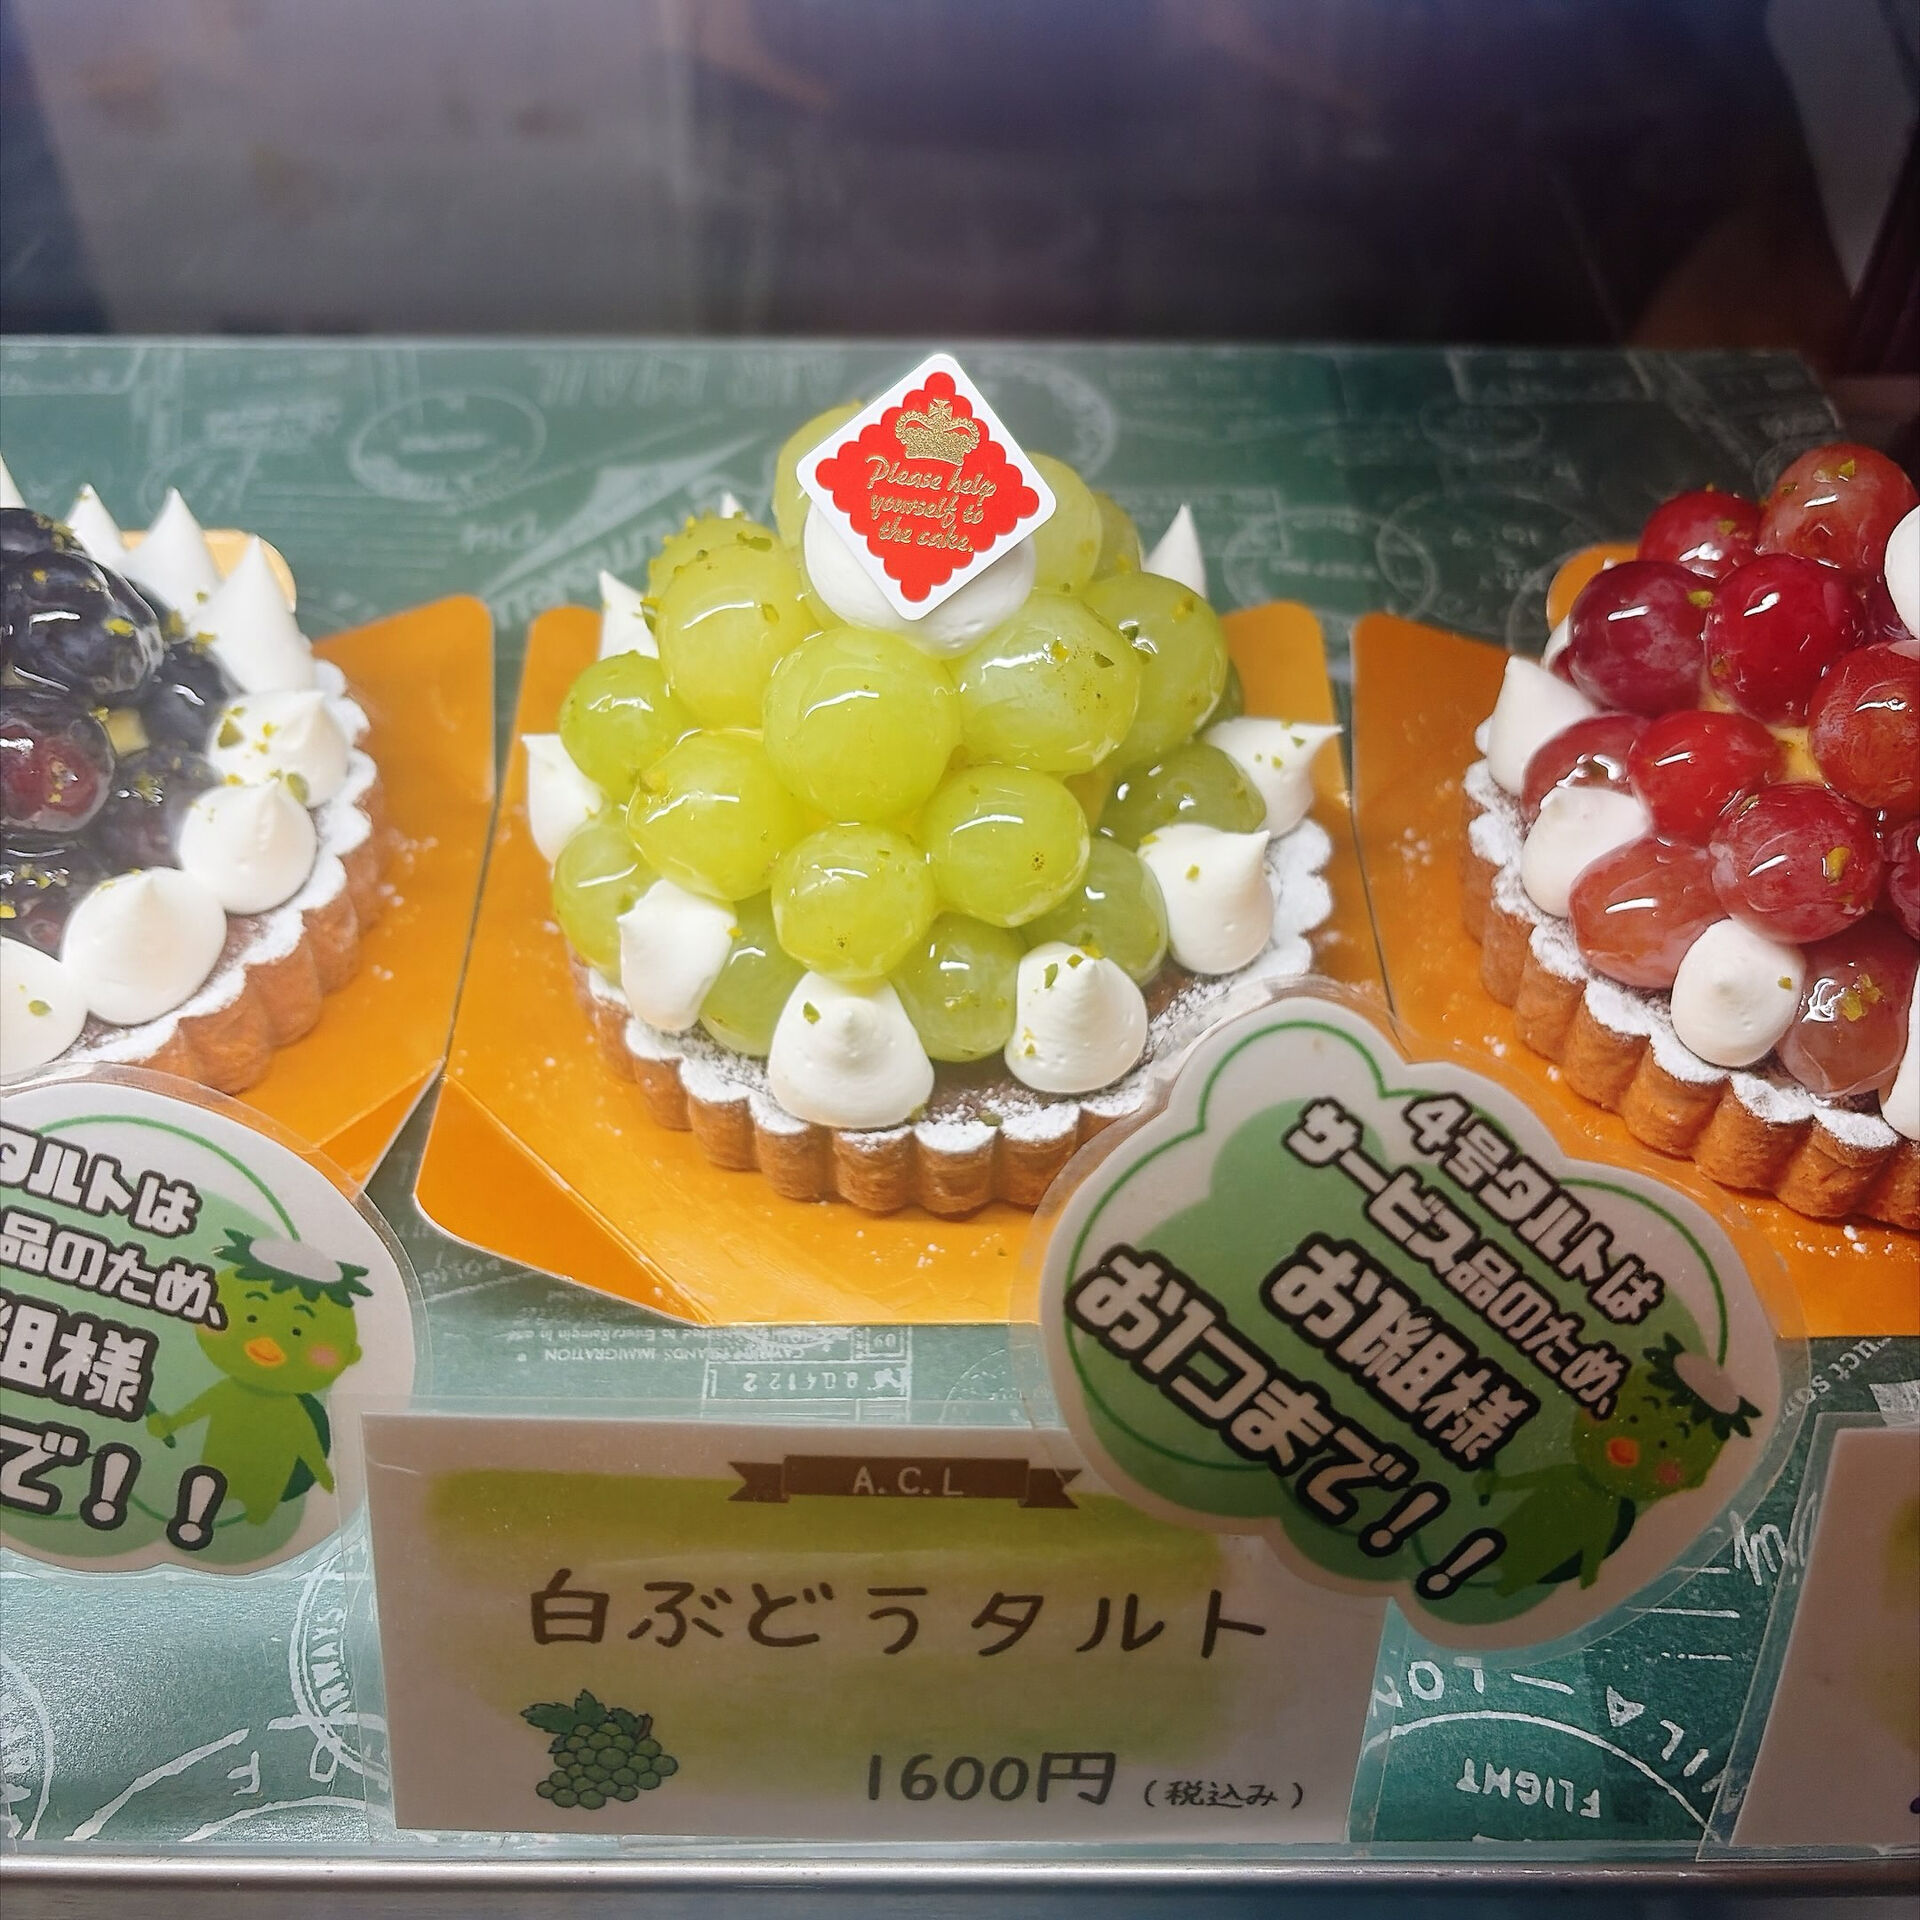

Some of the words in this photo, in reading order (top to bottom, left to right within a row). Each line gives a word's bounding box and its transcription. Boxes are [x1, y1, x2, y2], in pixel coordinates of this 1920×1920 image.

[865, 455, 942, 490] Please
[947, 468, 997, 506] help
[870, 493, 958, 529] yourself
[962, 503, 984, 525] to
[879, 518, 912, 544] the
[917, 521, 975, 553] cake.
[1404, 1094, 1663, 1323] 4号タルトは
[1284, 1099, 1632, 1418] サービス品のため、
[1262, 1236, 1538, 1467] お1組様
[530, 1567, 1268, 1659] 白ぶどうタルト
[868, 1751, 1117, 1805] 1600円
[1144, 1780, 1304, 1810] (税込み)
[1457, 1757, 1601, 1820] FLIGHT
